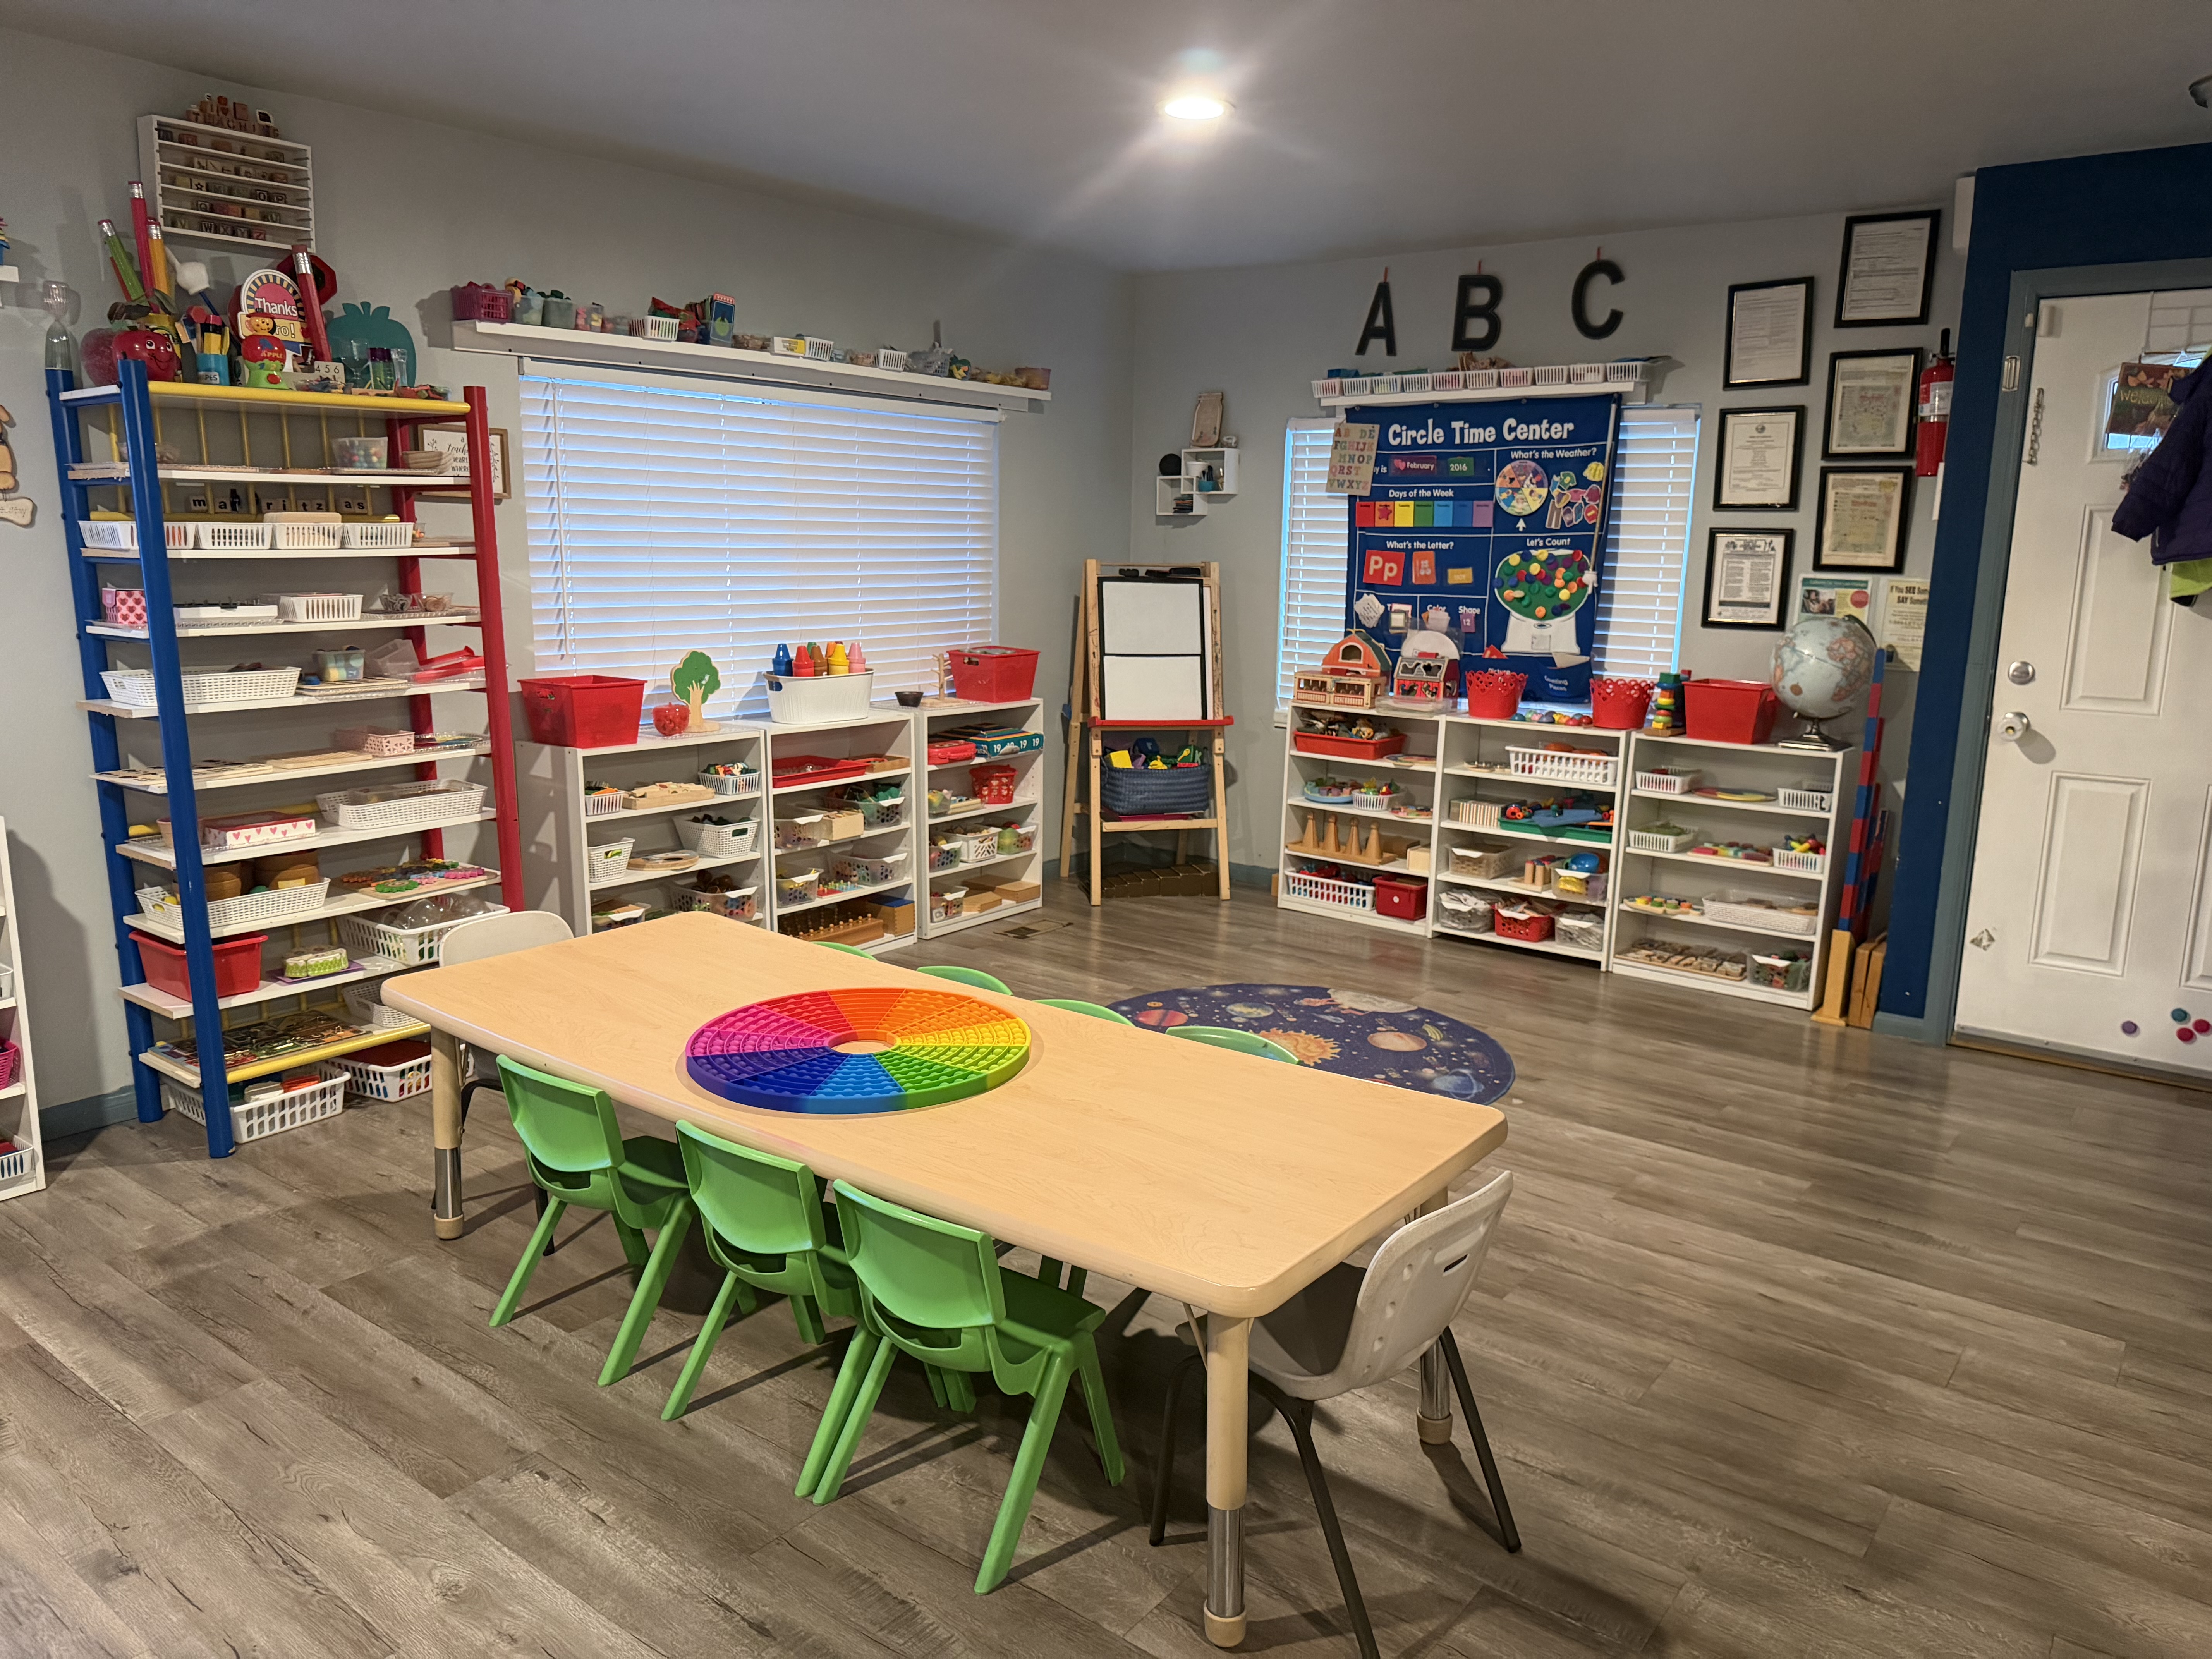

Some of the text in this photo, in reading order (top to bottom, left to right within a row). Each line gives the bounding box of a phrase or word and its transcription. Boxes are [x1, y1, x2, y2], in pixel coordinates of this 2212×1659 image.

[255, 297, 298, 317] Thanks
[1355, 259, 1626, 356] A B C
[1388, 418, 1574, 446] Circle Time Center
[1511, 447, 1597, 459] What's the Weather?
[1381, 465, 1387, 473] is
[1407, 462, 1434, 471] February
[1389, 489, 1407, 499] Days
[1408, 489, 1417, 497] of
[1433, 489, 1454, 497] Week
[1386, 541, 1412, 549] What's
[1527, 538, 1571, 546] Let's Count
[1369, 555, 1398, 581] Pp
[993, 744, 1001, 753] 19
[1020, 740, 1027, 749] 19
[1032, 738, 1040, 747] 19
